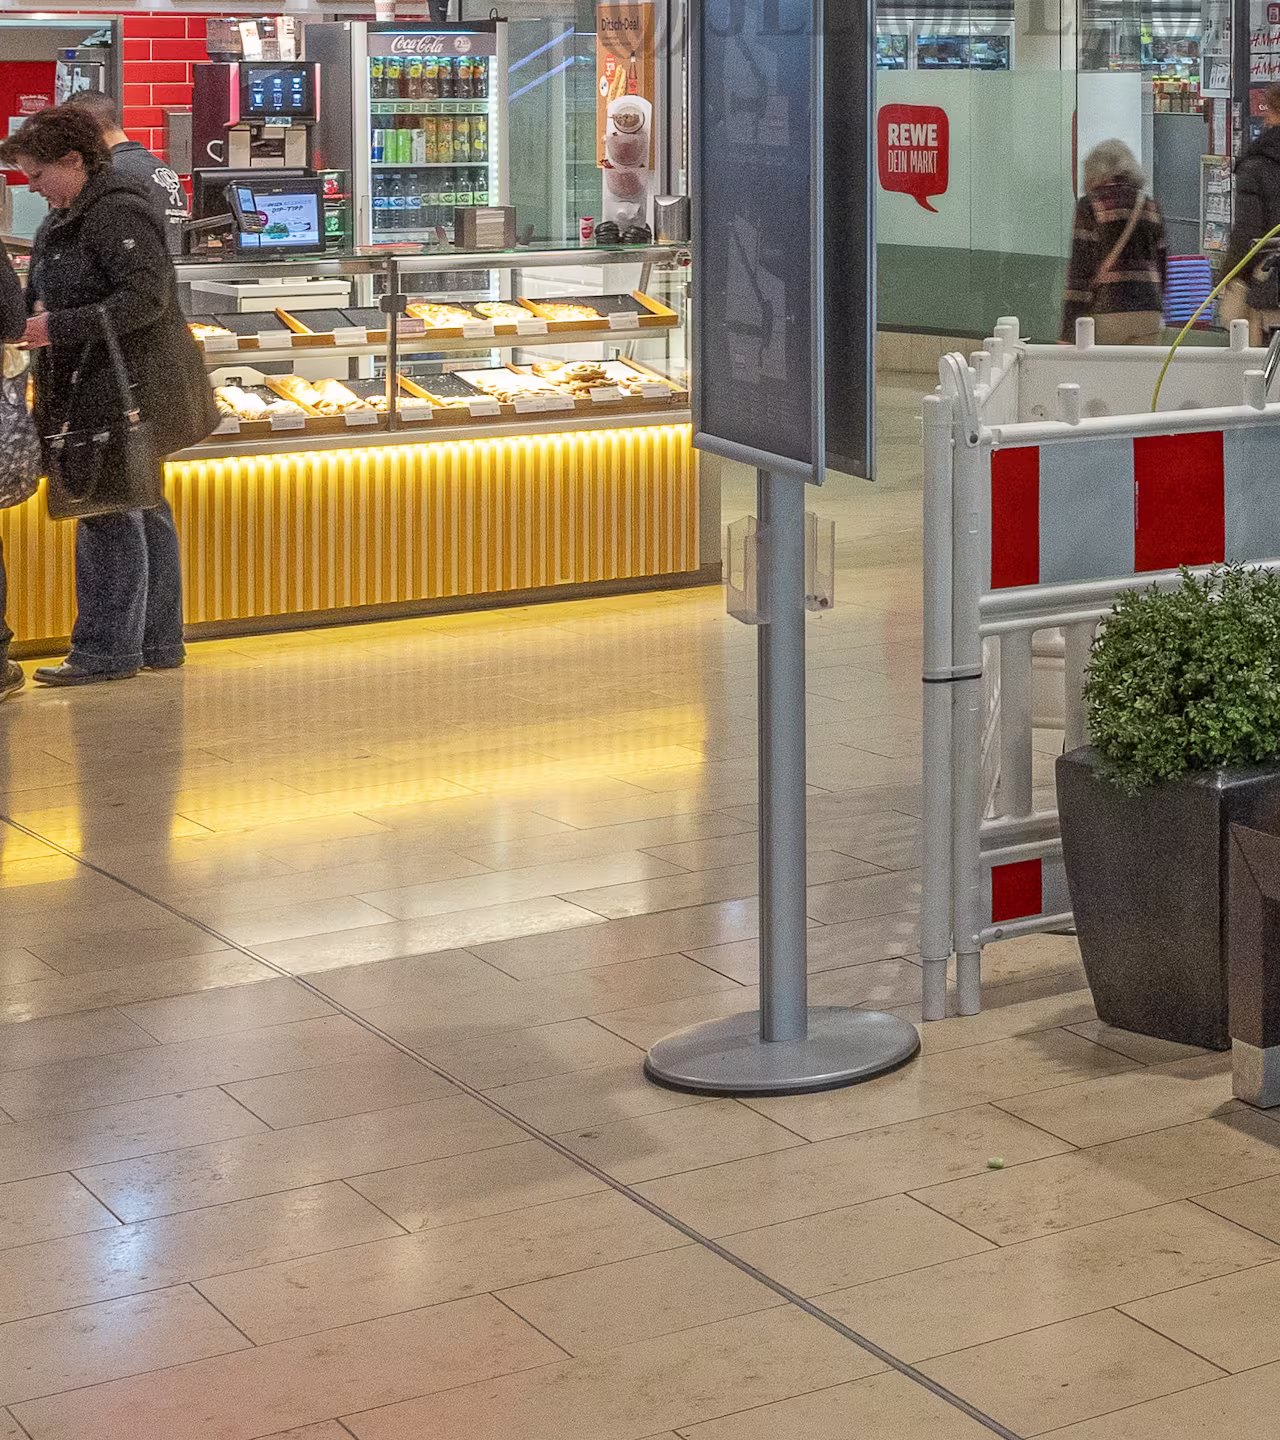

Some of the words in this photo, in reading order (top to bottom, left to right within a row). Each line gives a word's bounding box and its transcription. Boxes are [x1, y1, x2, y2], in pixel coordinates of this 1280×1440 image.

[601, 15, 639, 33] Ditsch-Deal
[391, 35, 446, 53] Coca-Cola
[887, 123, 939, 147] REWE
[887, 149, 908, 173] DEIN
[910, 150, 939, 174] MARKT
